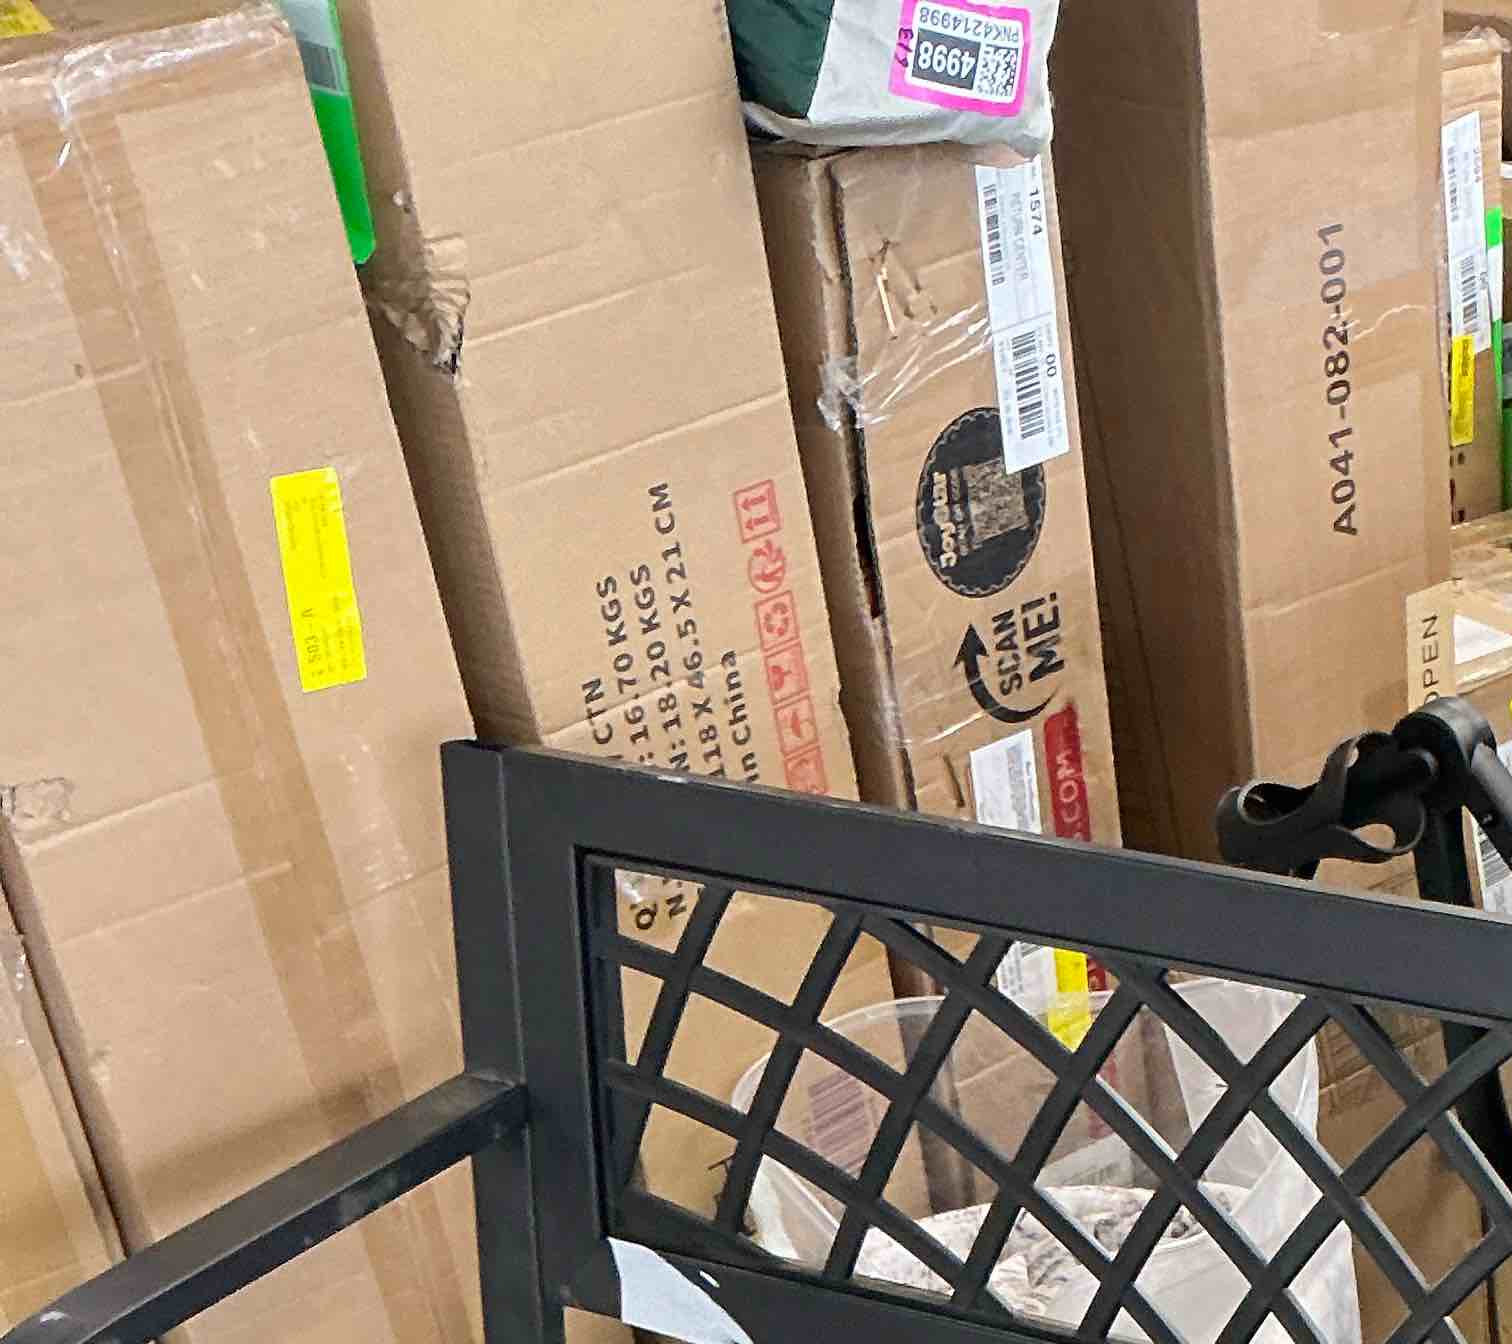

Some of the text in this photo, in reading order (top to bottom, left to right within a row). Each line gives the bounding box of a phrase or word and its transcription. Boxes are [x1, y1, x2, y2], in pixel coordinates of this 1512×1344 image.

[918, 41, 976, 80] 4998
[920, 7, 1019, 43] PNK4214998
[1317, 223, 1360, 537] A041-082-001
[648, 482, 676, 535] CM
[661, 541, 686, 584] 21
[596, 575, 628, 647] KGS
[629, 564, 661, 635] KGS
[669, 588, 692, 614] X
[676, 618, 704, 689] 46.5
[992, 608, 1025, 697] SCAN
[1020, 591, 1065, 684] ME!
[582, 677, 613, 745] CTN
[613, 652, 649, 746] 16.70
[646, 640, 683, 731] 18.20
[692, 696, 713, 719] X
[720, 650, 752, 746] China
